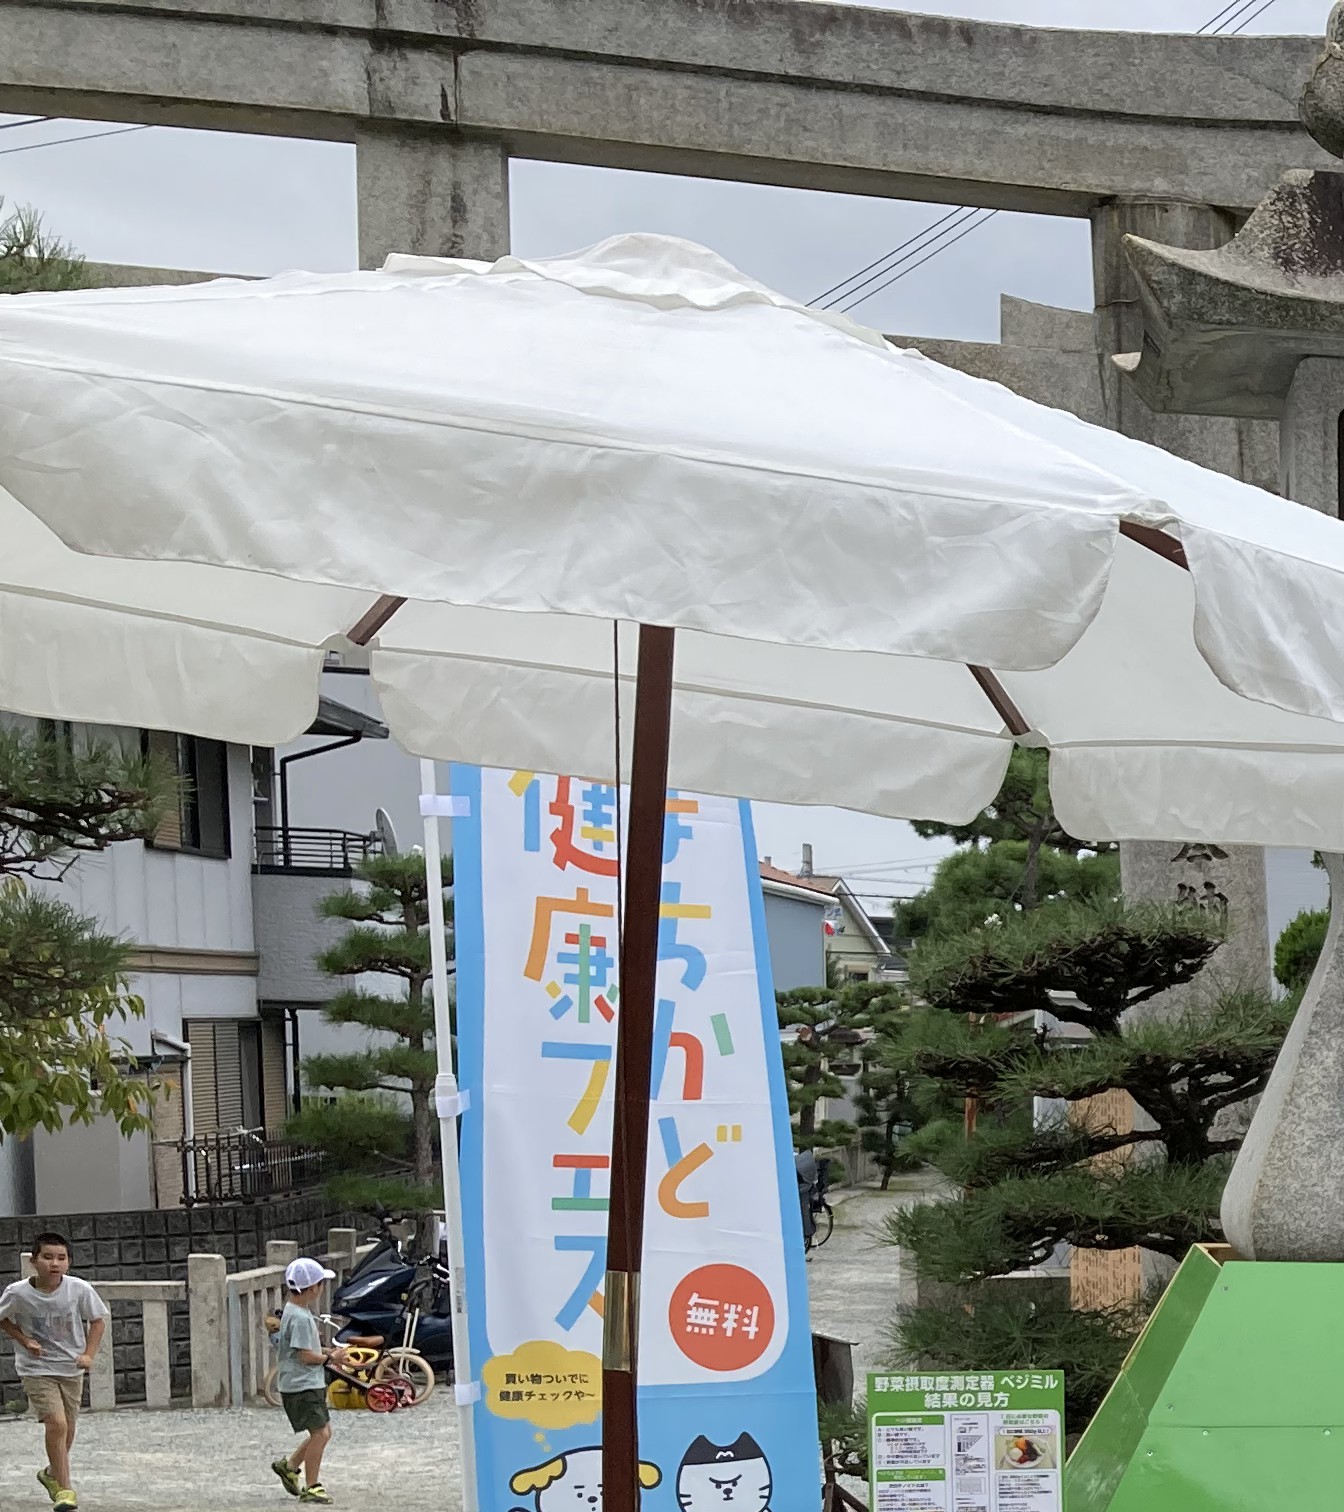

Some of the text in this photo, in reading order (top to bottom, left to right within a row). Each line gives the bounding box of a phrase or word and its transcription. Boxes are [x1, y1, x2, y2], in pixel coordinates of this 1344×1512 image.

[685, 1292, 760, 1340] 無料
[505, 1373, 589, 1385] 買い物ついでに
[874, 1374, 1059, 1392] 野菜摂取度測定器 ベジミル
[924, 1391, 1010, 1409] 結果の見方
